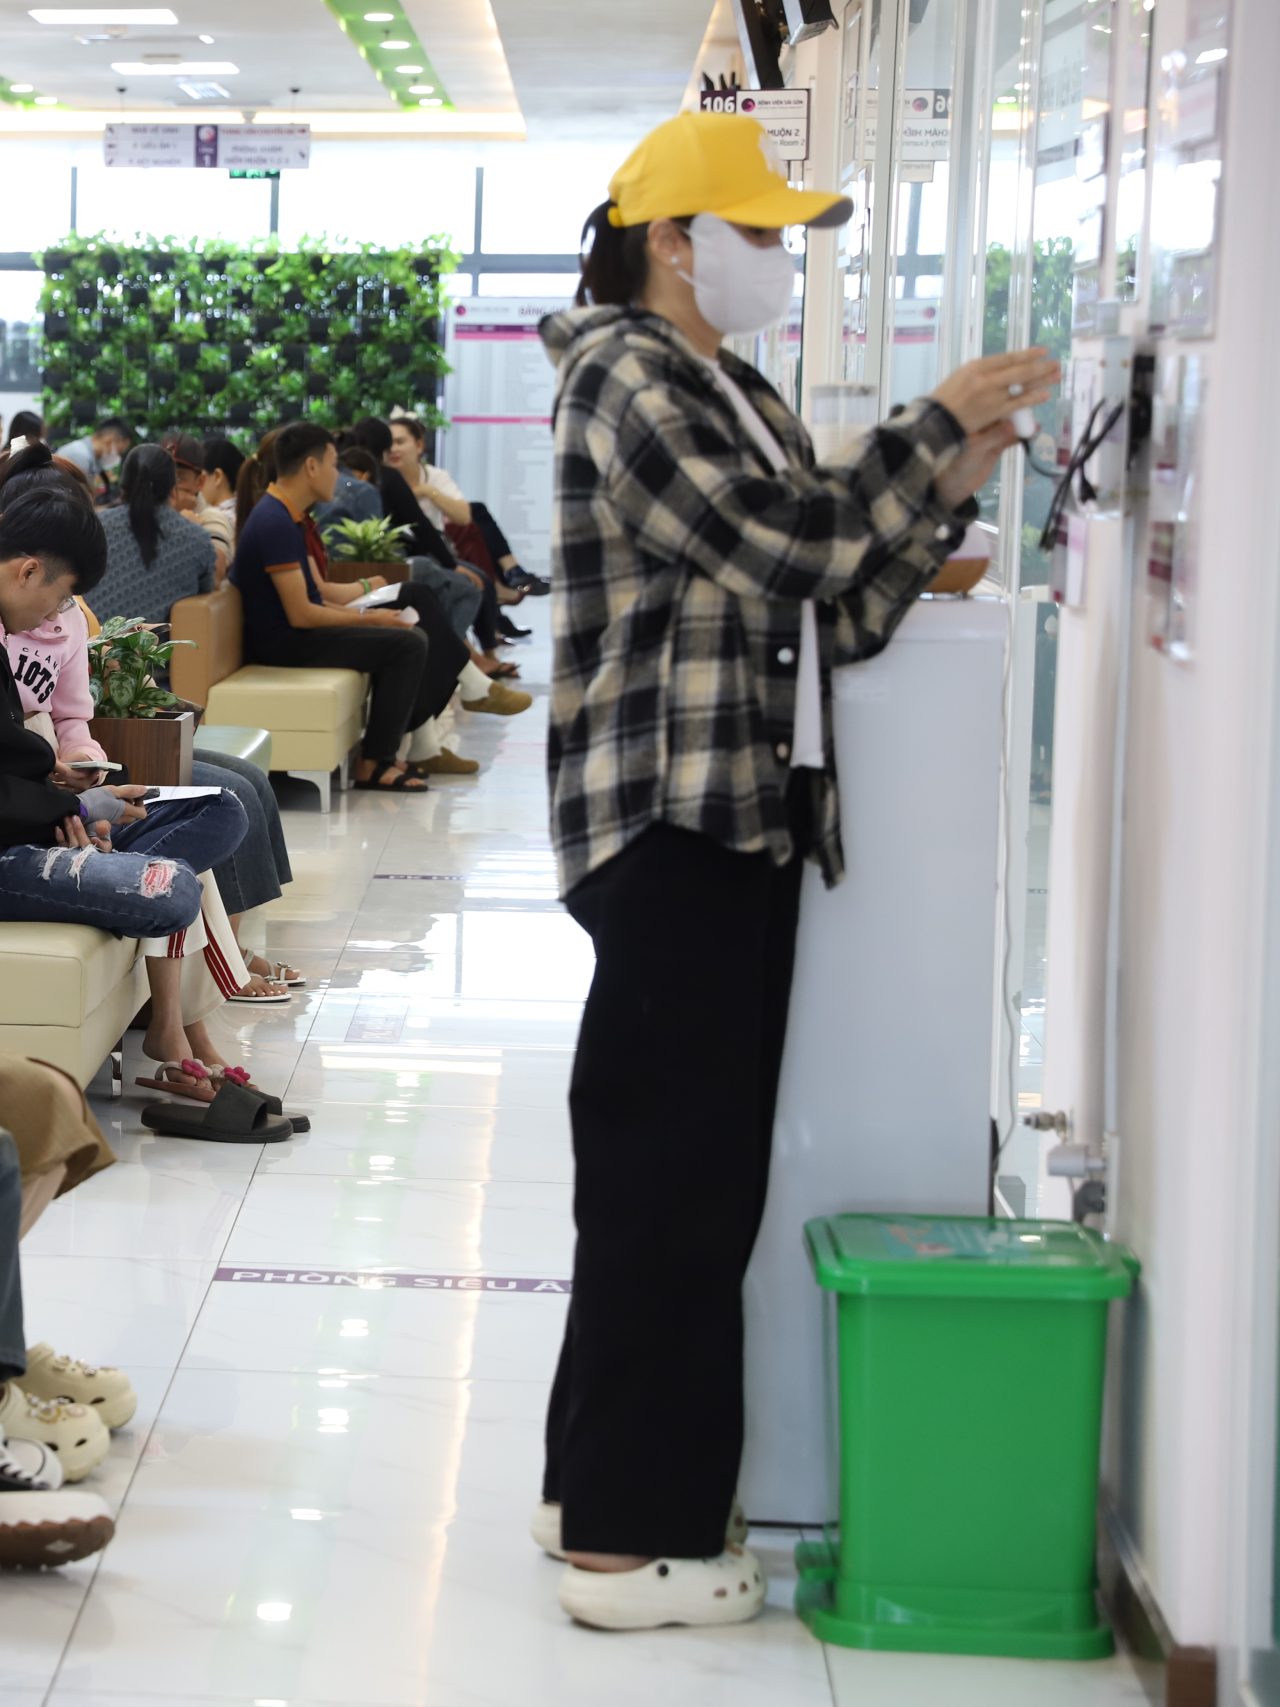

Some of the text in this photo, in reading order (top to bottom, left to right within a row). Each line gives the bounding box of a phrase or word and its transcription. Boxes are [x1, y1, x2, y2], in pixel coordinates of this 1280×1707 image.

[702, 96, 735, 113] 106
[794, 129, 800, 137] 2
[13, 653, 56, 705] IOTS
[231, 1270, 570, 1293] PHÒNG SIÊU Â
